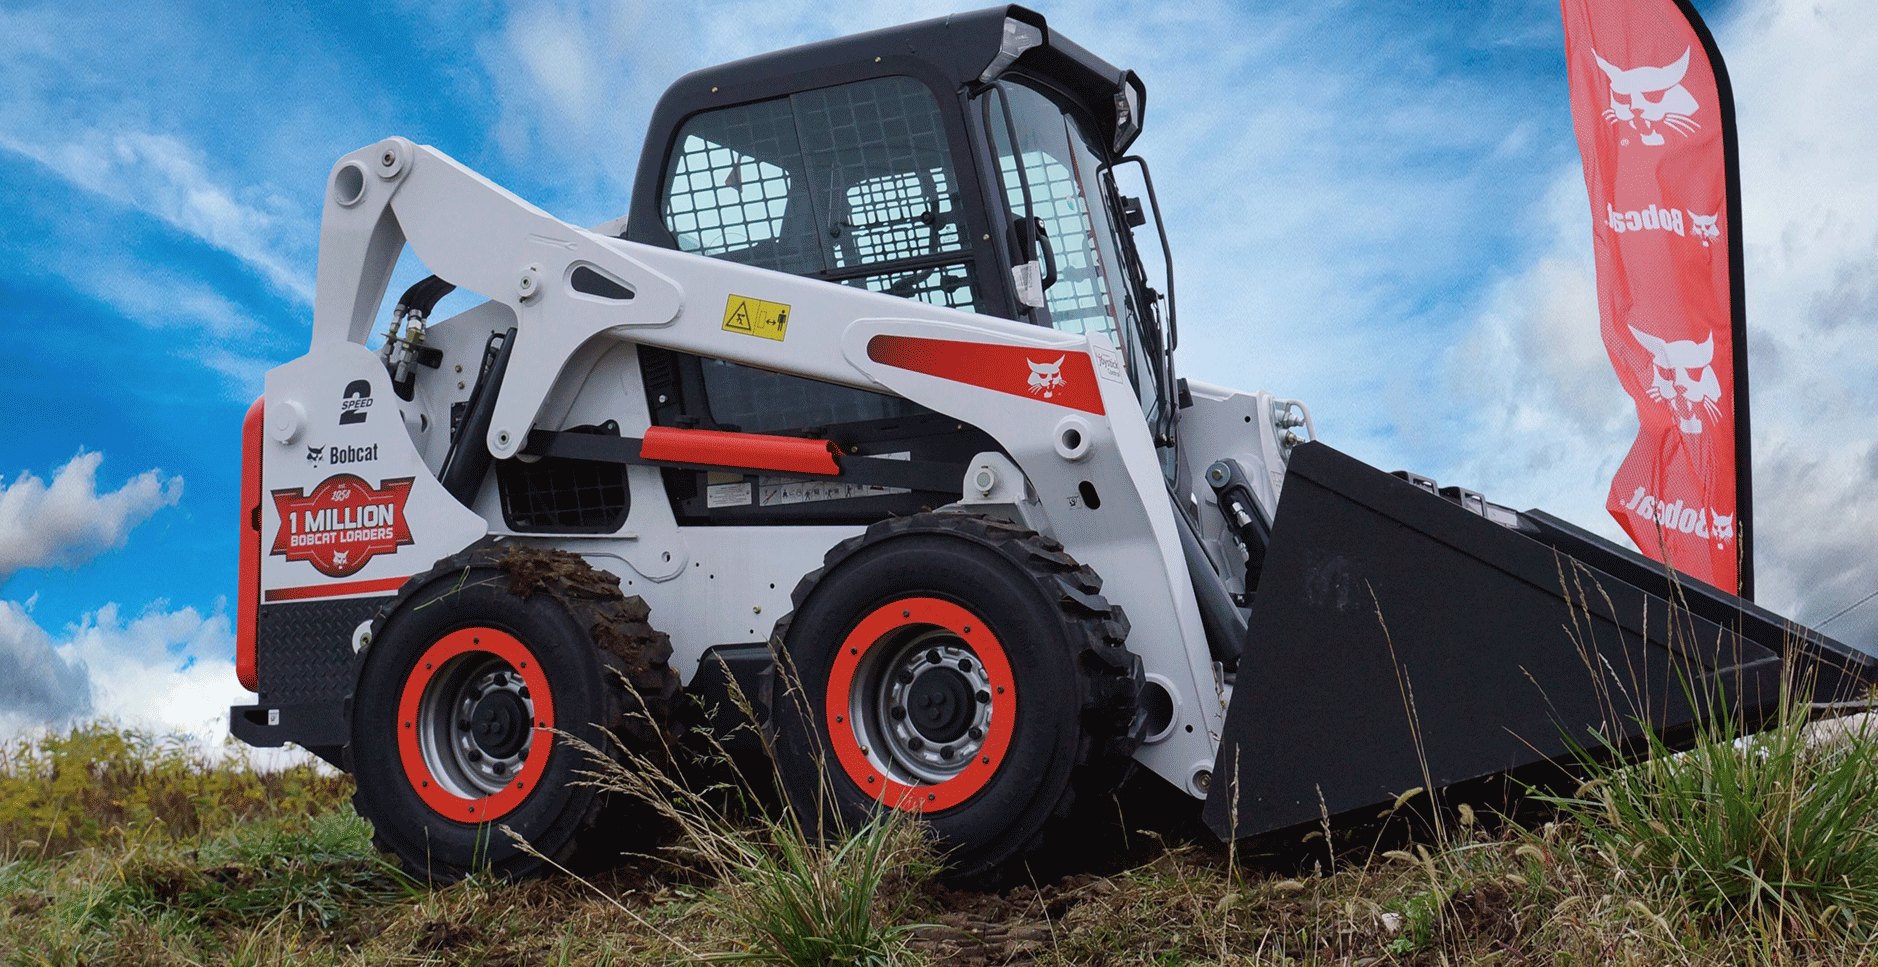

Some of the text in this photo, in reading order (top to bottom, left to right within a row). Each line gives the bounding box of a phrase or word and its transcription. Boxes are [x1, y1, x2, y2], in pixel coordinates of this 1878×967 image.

[339, 379, 371, 426] 2
[341, 398, 374, 411] SPEED
[330, 443, 378, 465] Bobcat
[289, 502, 395, 535] 1 MILLION
[290, 527, 394, 547] BOBCAT LOADERS
